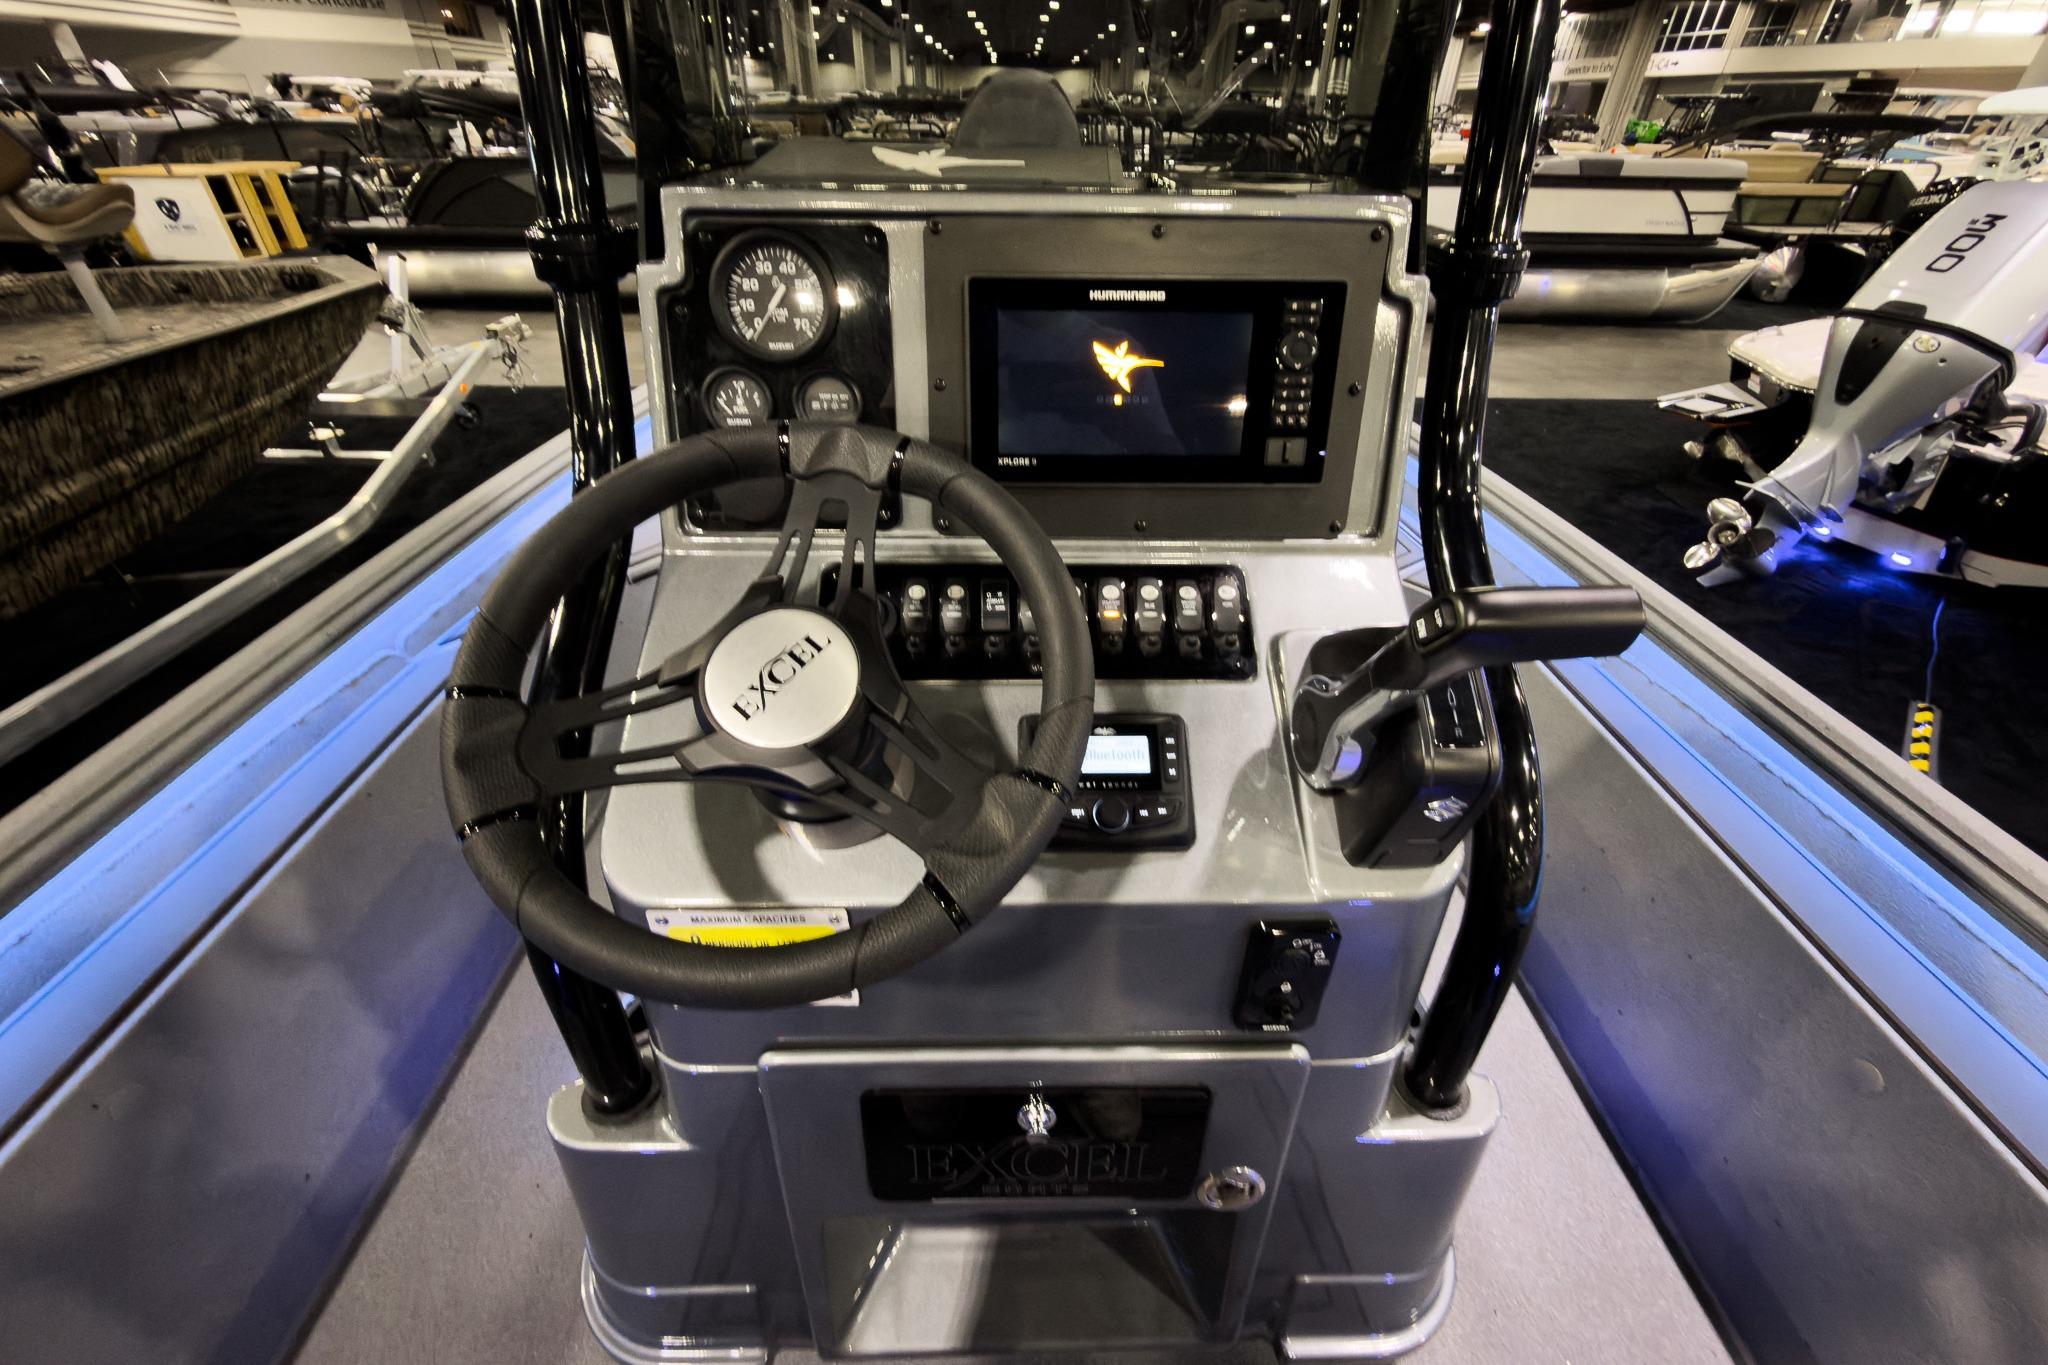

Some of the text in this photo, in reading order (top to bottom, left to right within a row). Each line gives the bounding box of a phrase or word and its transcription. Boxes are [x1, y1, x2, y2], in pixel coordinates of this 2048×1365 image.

[1925, 213, 2008, 273] 300
[779, 261, 796, 275] 40
[1089, 289, 1166, 302] HUMMINBIRD
[739, 298, 755, 312] 10
[793, 317, 810, 332] 70
[997, 457, 1030, 466] XPLORE
[732, 633, 832, 721] EXCEL
[690, 915, 807, 924] MAXIMUM CAPACITIES
[906, 1141, 1168, 1188] EXCEL
